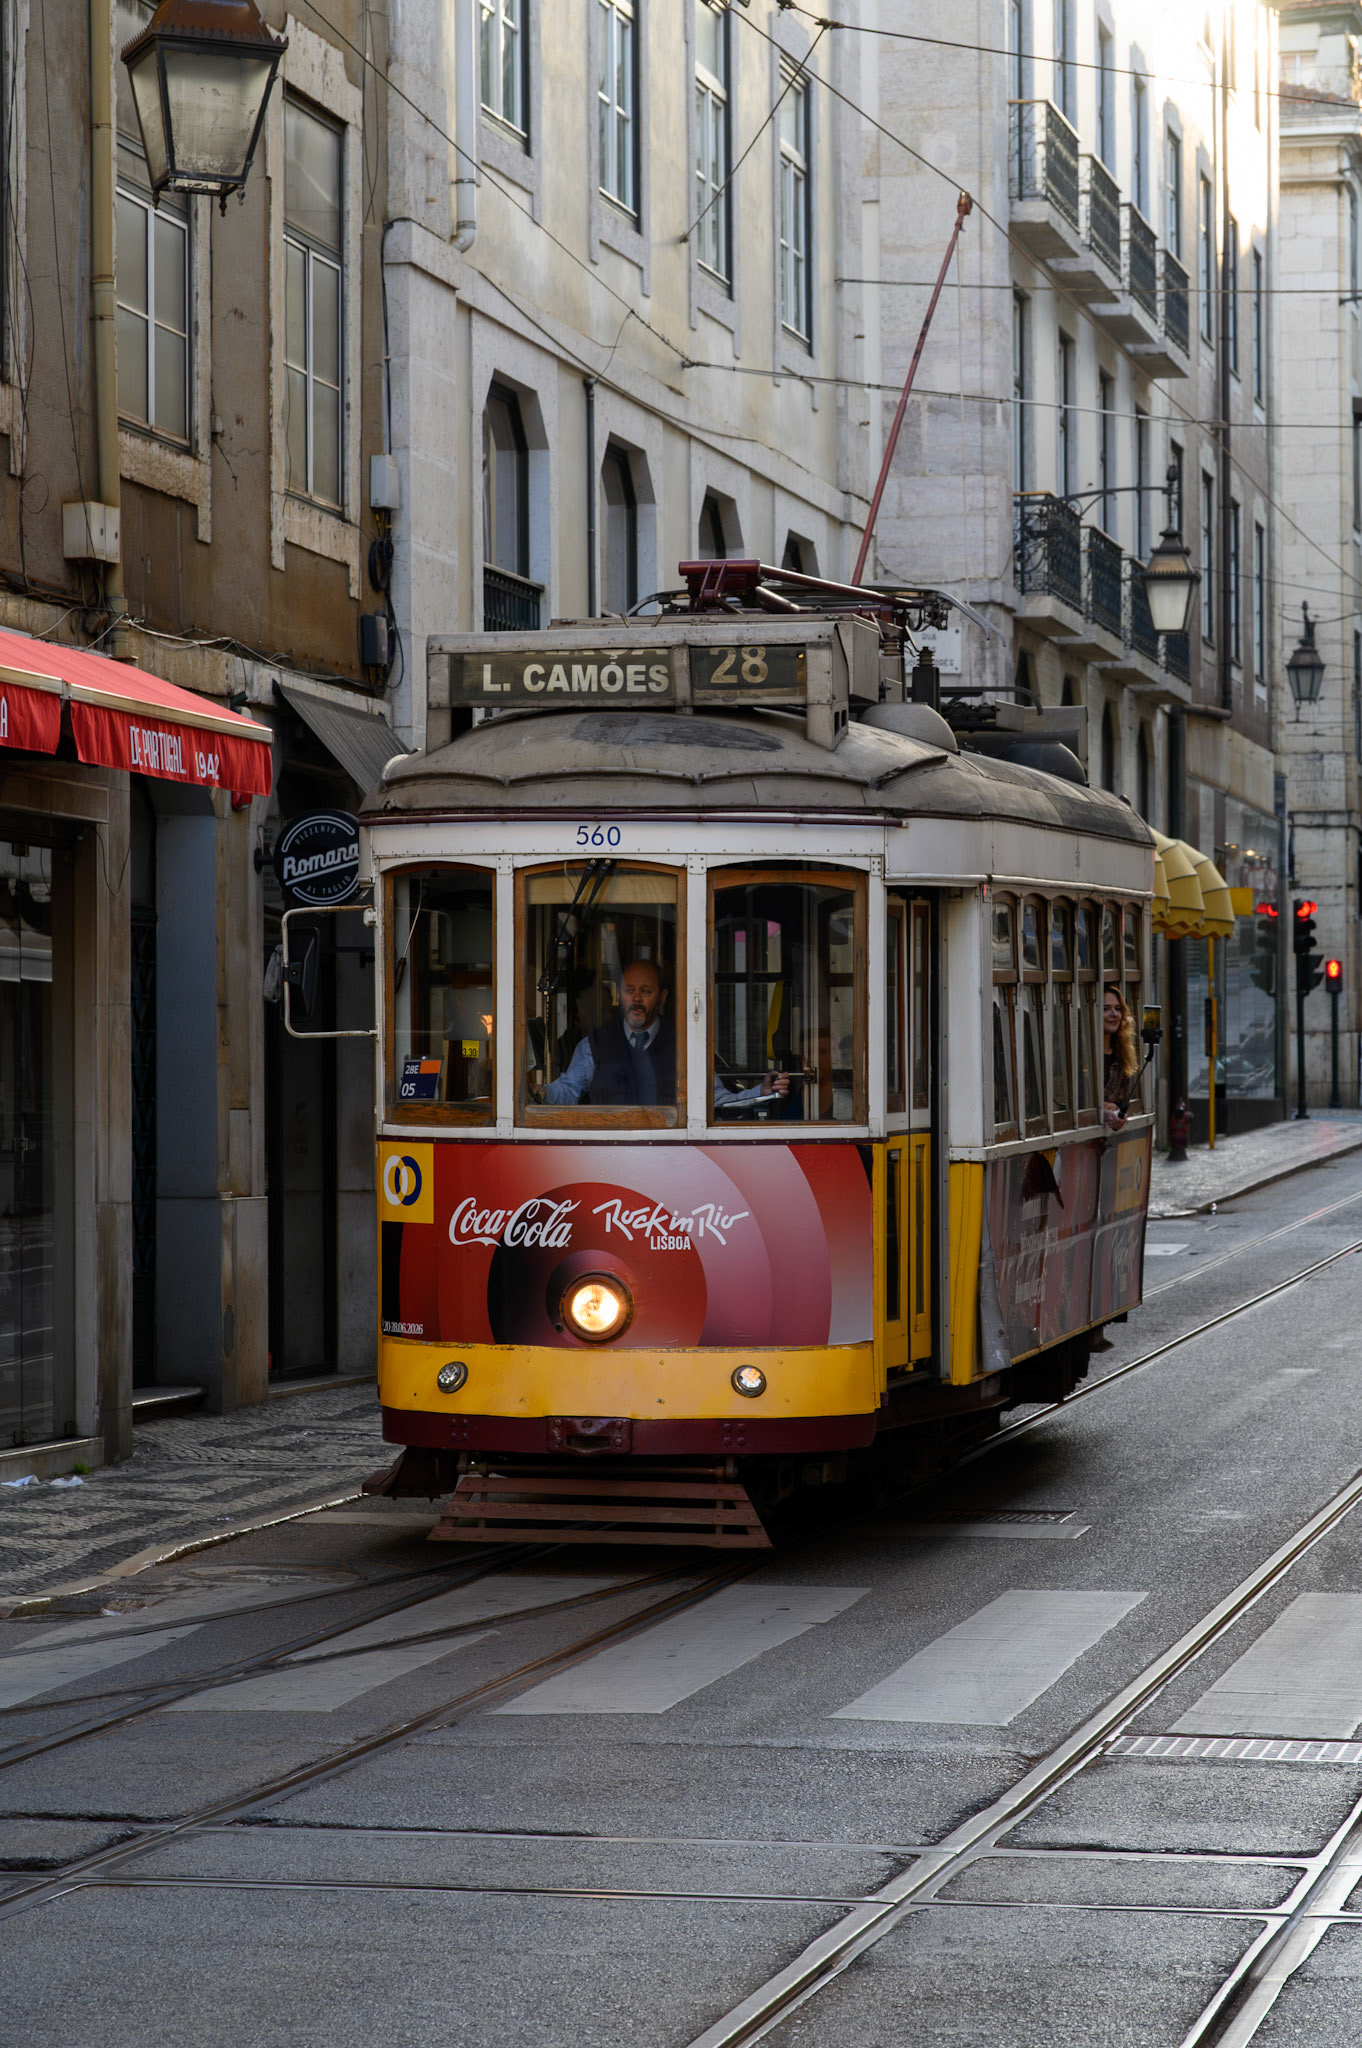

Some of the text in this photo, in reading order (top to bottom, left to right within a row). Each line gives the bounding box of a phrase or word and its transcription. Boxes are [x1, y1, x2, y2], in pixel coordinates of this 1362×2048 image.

[482, 661, 670, 693] L. CAMÕES
[709, 645, 769, 684] 28
[130, 725, 143, 766] DE
[195, 751, 220, 780] 1942
[295, 825, 336, 845] PIZZERIA
[576, 825, 621, 846] 560
[283, 843, 359, 879] Romana
[306, 875, 351, 895] AL TAGLIO
[405, 1064, 420, 1075] 28E
[401, 1083, 416, 1097] 05
[449, 1197, 582, 1248] Coca-Cola
[592, 1198, 750, 1246] Rock in Rio
[650, 1235, 692, 1250] LISBOA
